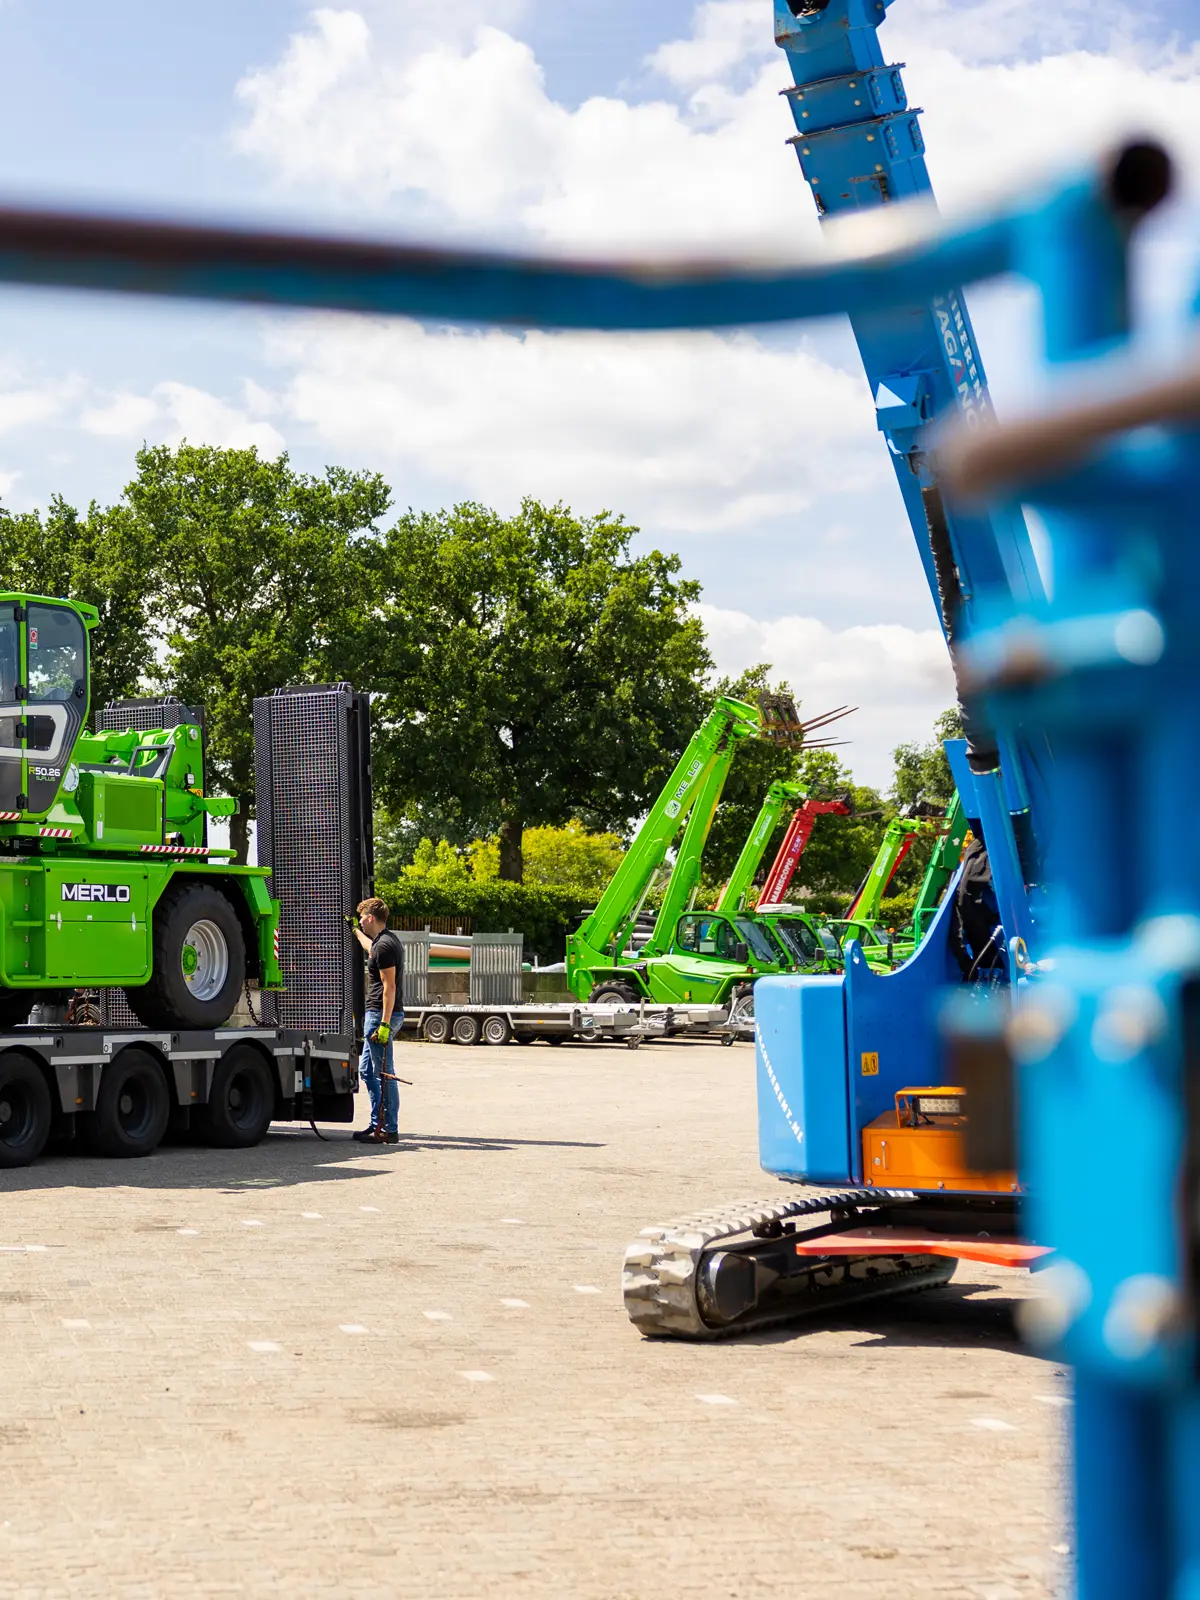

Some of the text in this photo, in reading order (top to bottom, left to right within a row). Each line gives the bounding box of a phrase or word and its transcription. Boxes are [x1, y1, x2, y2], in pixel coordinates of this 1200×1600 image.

[28, 766, 61, 777] R50.26
[675, 760, 701, 799] MELO
[62, 883, 130, 902] MERLO
[770, 857, 795, 903] MANISCOPIC
